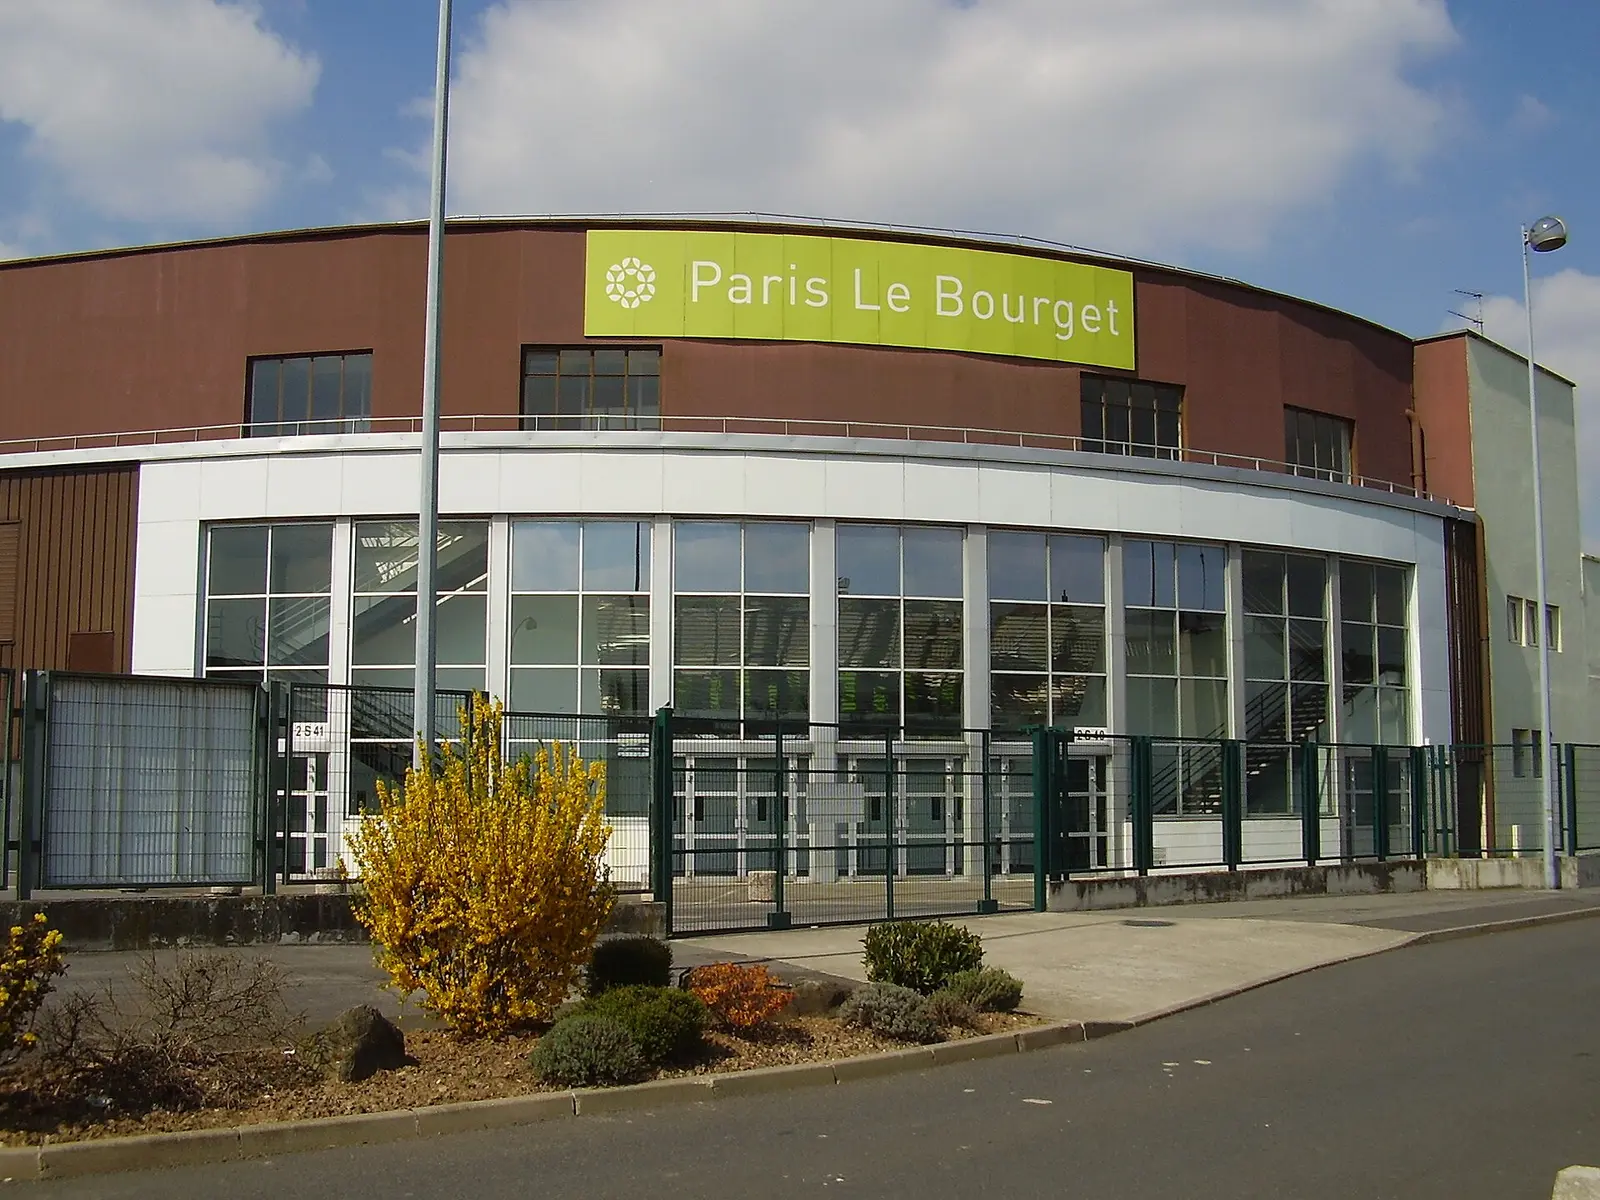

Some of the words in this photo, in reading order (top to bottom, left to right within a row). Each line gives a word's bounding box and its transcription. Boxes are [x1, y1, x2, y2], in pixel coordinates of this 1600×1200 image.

[691, 260, 829, 308] Paris
[854, 268, 911, 313] Le
[936, 275, 1119, 341] Bourget
[296, 725, 301, 736] 2
[304, 725, 311, 736] S
[313, 725, 323, 736] 41
